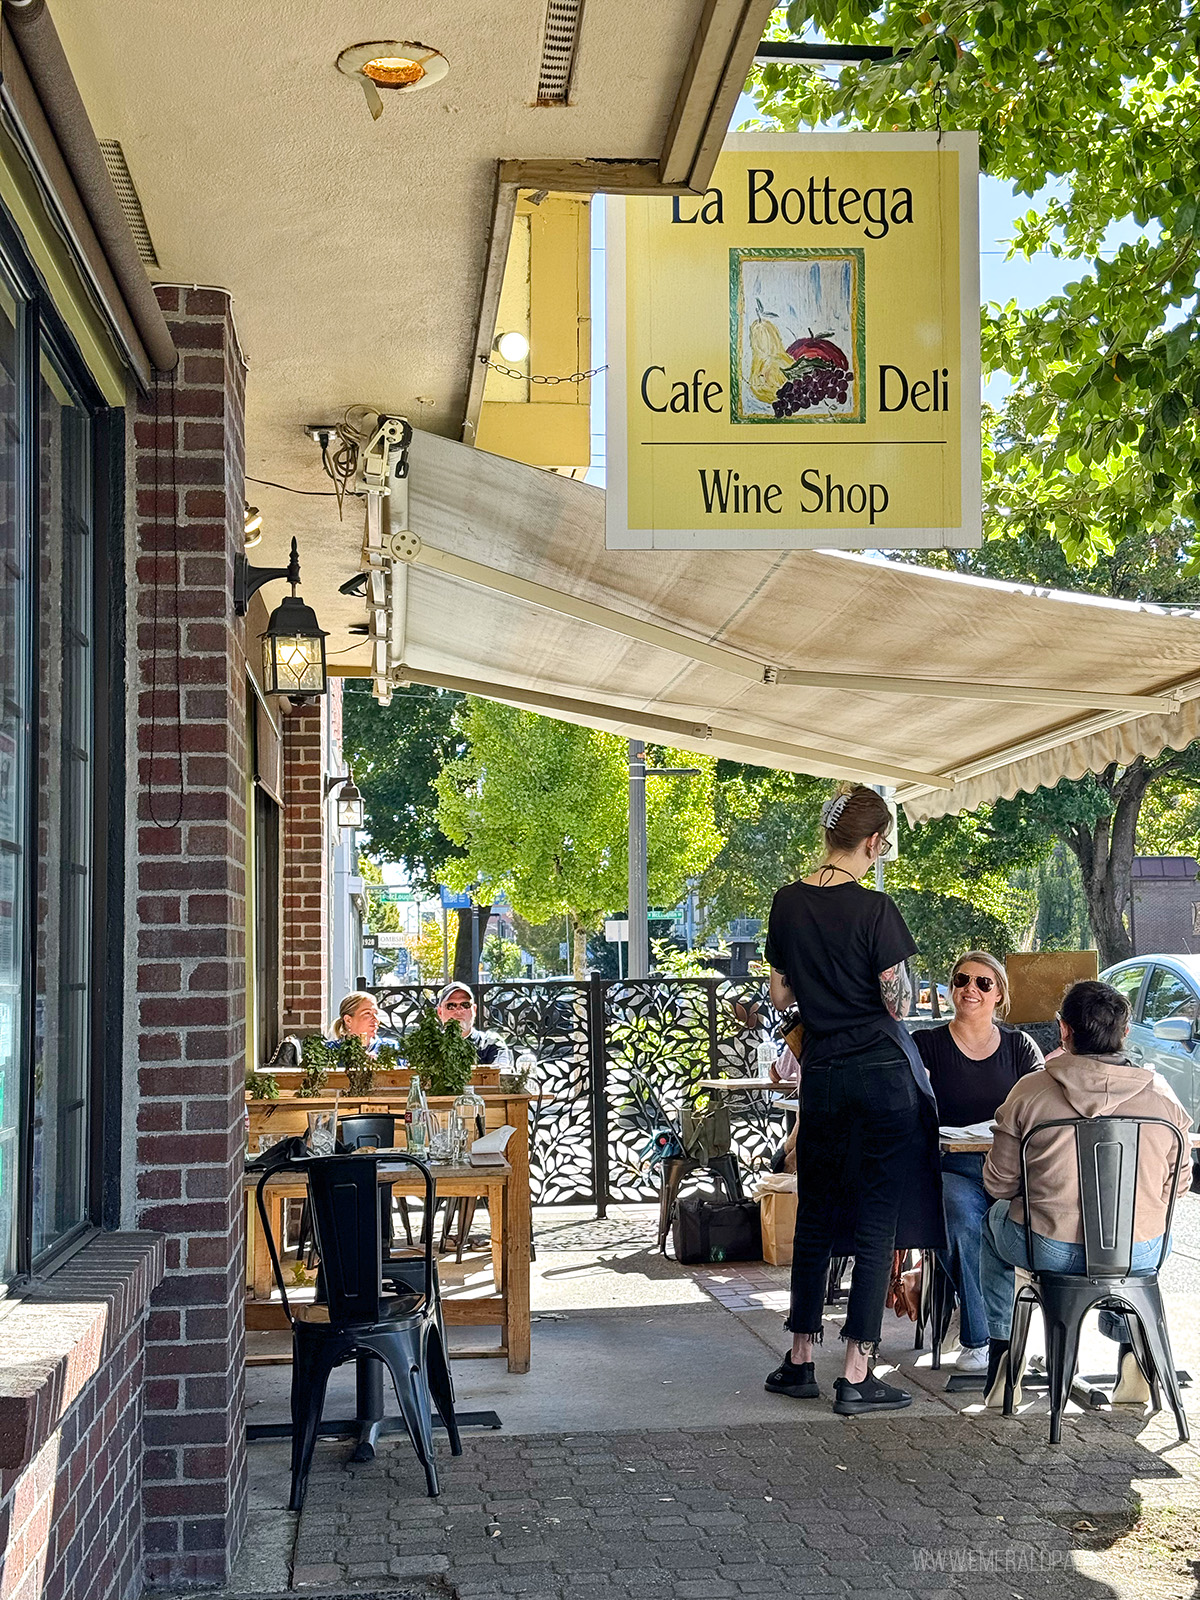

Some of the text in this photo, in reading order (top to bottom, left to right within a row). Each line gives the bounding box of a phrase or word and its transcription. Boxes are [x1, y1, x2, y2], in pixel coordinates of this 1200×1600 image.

[671, 169, 914, 240] La Bottega
[641, 365, 723, 413] Cafe
[878, 364, 950, 413] Deli
[698, 468, 889, 525] Wine Shop
